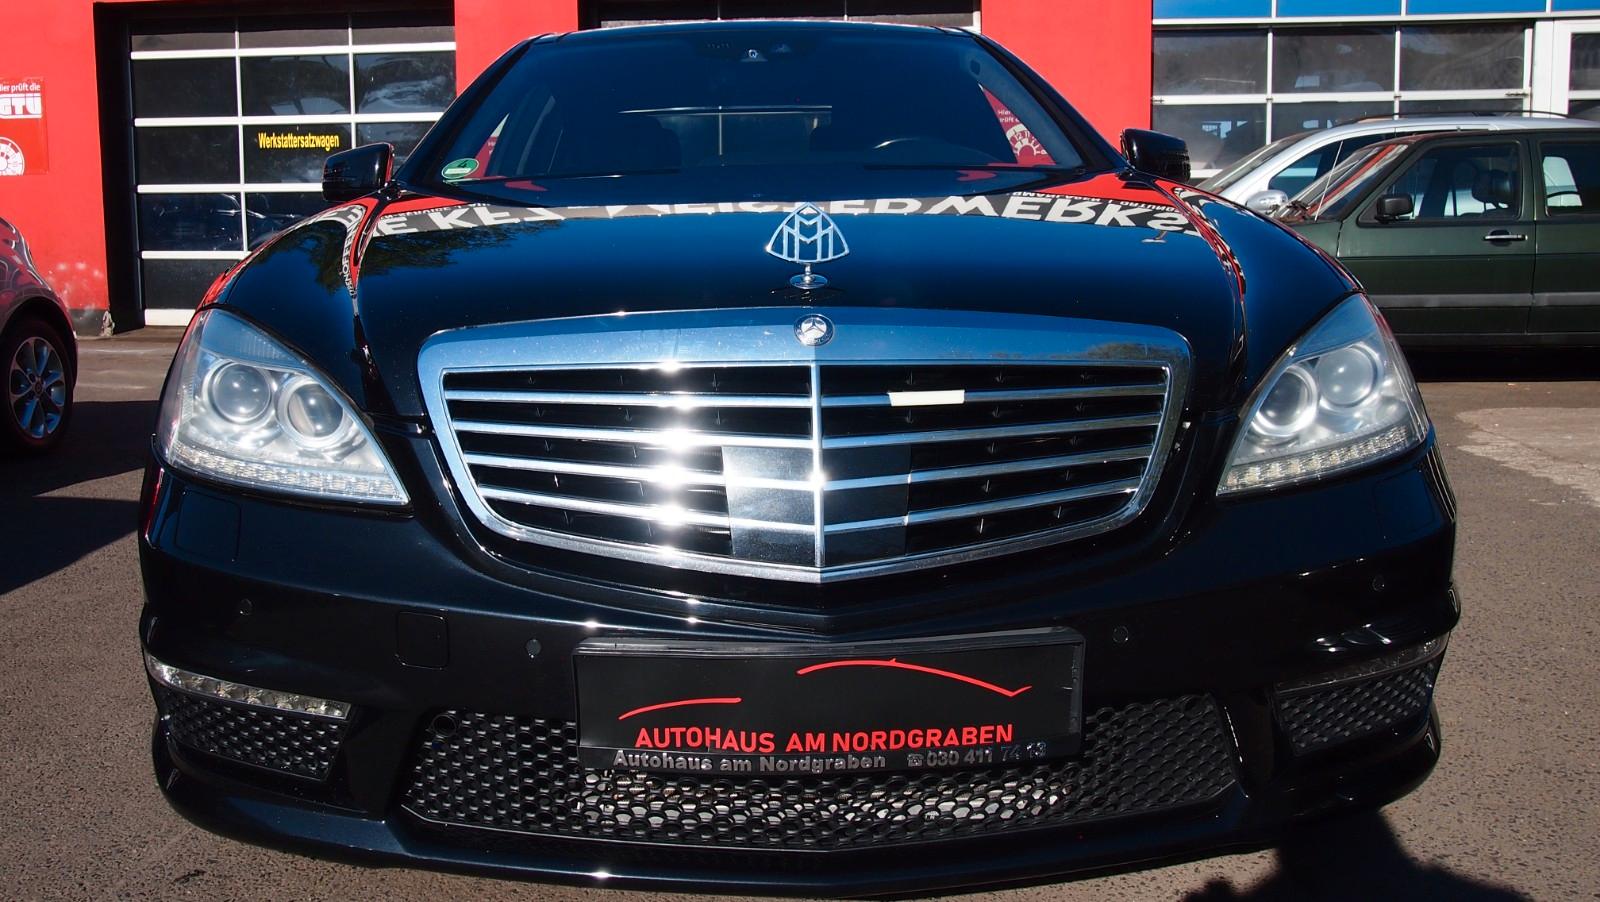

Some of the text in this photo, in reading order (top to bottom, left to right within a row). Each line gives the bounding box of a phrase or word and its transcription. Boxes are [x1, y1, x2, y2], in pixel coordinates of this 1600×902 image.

[11, 82, 28, 93] prüft
[29, 82, 41, 91] die
[258, 132, 340, 152] Werkstattersatzwagen
[458, 159, 468, 168] 4
[635, 724, 1013, 753] AUTOHAUS AM NORDGRABEN
[613, 750, 713, 771] Autohaus
[719, 758, 751, 772] am
[759, 755, 886, 774] Nordgraben
[926, 750, 960, 767] 030
[963, 749, 993, 764] 411
